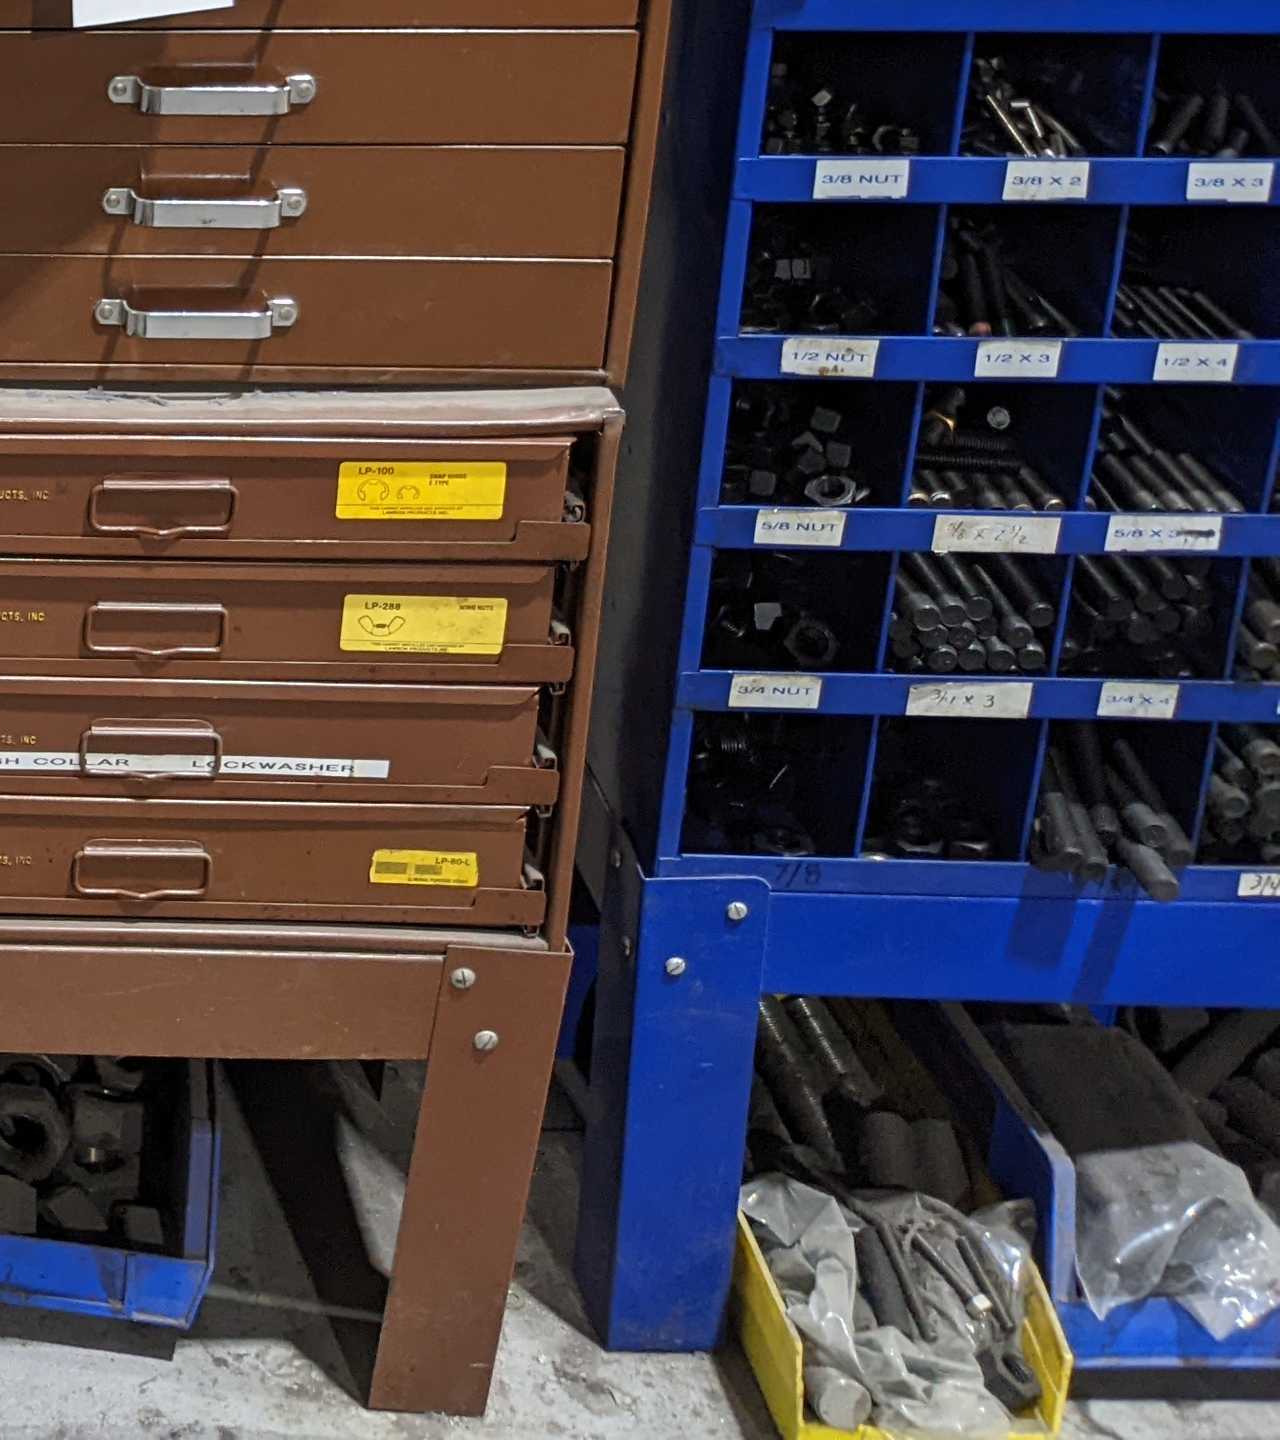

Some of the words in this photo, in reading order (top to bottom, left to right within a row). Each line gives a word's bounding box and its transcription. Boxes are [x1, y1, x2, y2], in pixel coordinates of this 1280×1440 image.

[821, 173, 852, 184] 3/8
[858, 174, 903, 184] NUT
[1012, 175, 1042, 186] 3/8
[1068, 176, 1081, 186] 2
[1194, 177, 1225, 187] 3/8
[1251, 178, 1264, 187] 3
